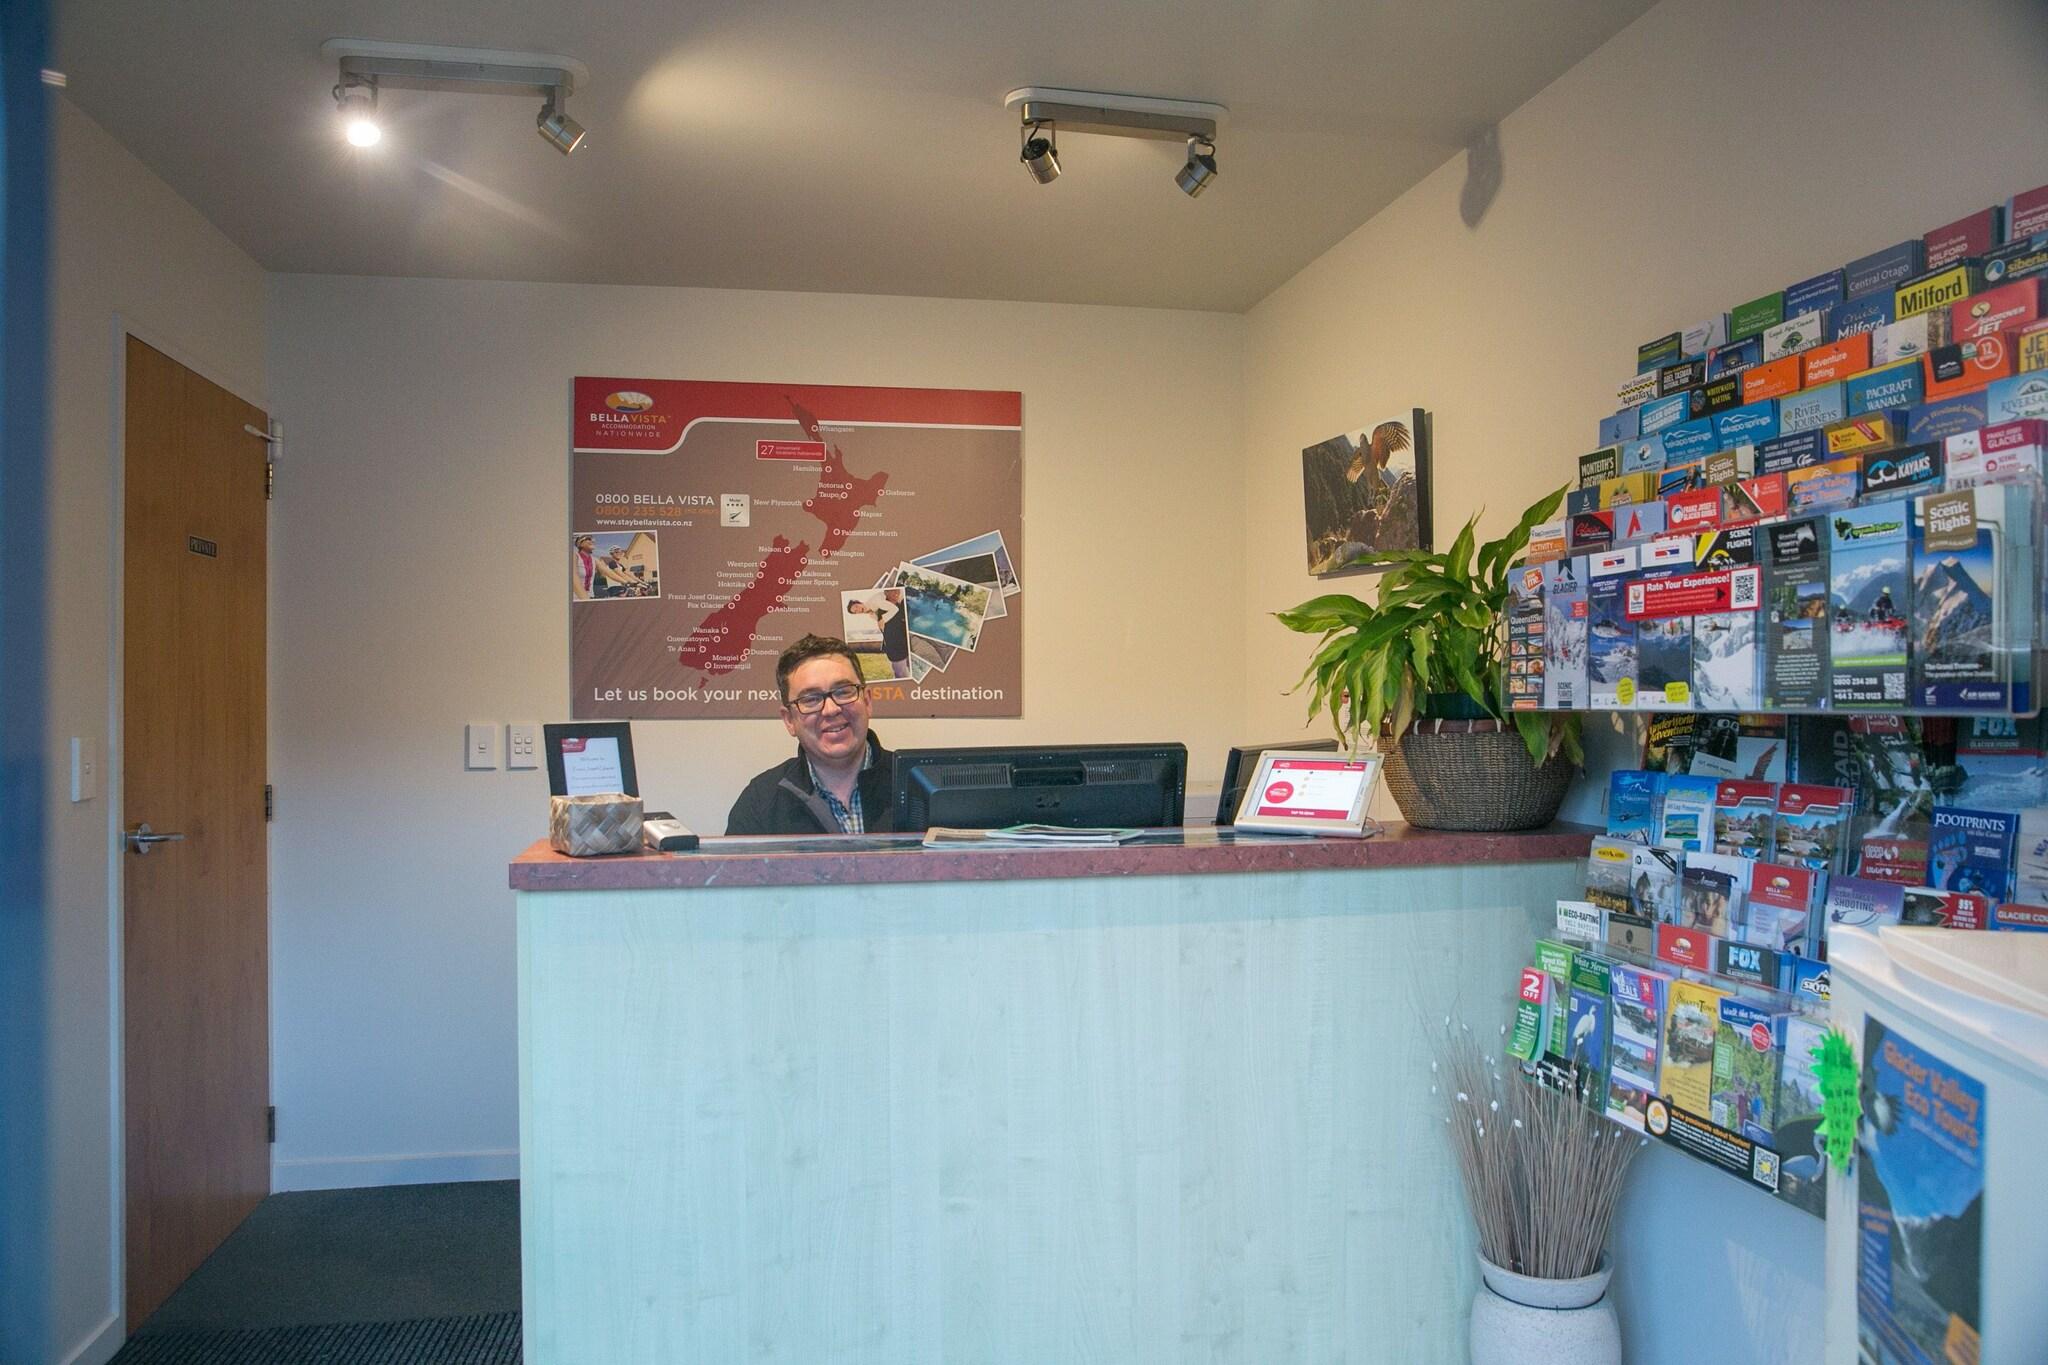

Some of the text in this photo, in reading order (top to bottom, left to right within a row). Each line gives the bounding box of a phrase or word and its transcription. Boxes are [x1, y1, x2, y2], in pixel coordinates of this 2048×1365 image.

[1929, 243, 1968, 264] MILFORD
[1850, 263, 1909, 291] Central Otago
[1901, 276, 1962, 315] Milford
[1838, 315, 1885, 340] Milford
[1972, 319, 2003, 338] JET
[1808, 352, 1848, 369] Adventure
[1808, 367, 1835, 381] Rafting
[1866, 378, 1913, 400] PACKRAFT
[1867, 394, 1907, 411] WANAKA
[1794, 410, 1837, 432] JOURNEYS
[1987, 433, 2025, 449] GLACIER
[760, 445, 774, 455] 27
[1581, 457, 1614, 477] MONTEITH'S
[1709, 458, 1733, 473] Scenic
[1897, 457, 1931, 478] KAYAKS
[1710, 469, 1735, 484] Flights
[596, 494, 715, 506] 0800 BELLA VISTA
[770, 499, 802, 507] Plymouth
[596, 506, 630, 516] 0800
[633, 506, 655, 516] 235
[659, 506, 682, 516] 528
[861, 511, 883, 519] Napier
[1929, 500, 1969, 520] Scenic
[596, 518, 693, 527] www.staybellavista.co.nz
[1930, 514, 1971, 533] Flights
[1729, 528, 1752, 539] SCENIC
[1726, 538, 1752, 550] FLIGHTS
[829, 550, 865, 558] Wellington
[716, 571, 754, 579] Greymouth
[814, 579, 839, 587] Springs
[1646, 573, 1731, 592] Rate Your Experience!
[1553, 582, 1578, 595] GLACIER
[594, 687, 622, 701] Let
[628, 689, 648, 701] us
[653, 687, 698, 701] book
[703, 689, 743, 703] your
[910, 686, 1004, 700] destination
[1973, 717, 2017, 736] FOX
[1934, 813, 2006, 832] FOOTPRINTS
[1834, 898, 1874, 912] SHOOTING
[1998, 910, 2031, 922] GLACIER
[1574, 955, 1589, 968] White
[1590, 960, 1609, 974] Heron
[1728, 946, 1761, 970] FOX
[1528, 973, 1540, 993] 2
[1523, 990, 1539, 1000] OFF
[1884, 1039, 1979, 1124] Glacier Valley
[1904, 1081, 1930, 1118] Eco
[1934, 1099, 1979, 1149] Tours
